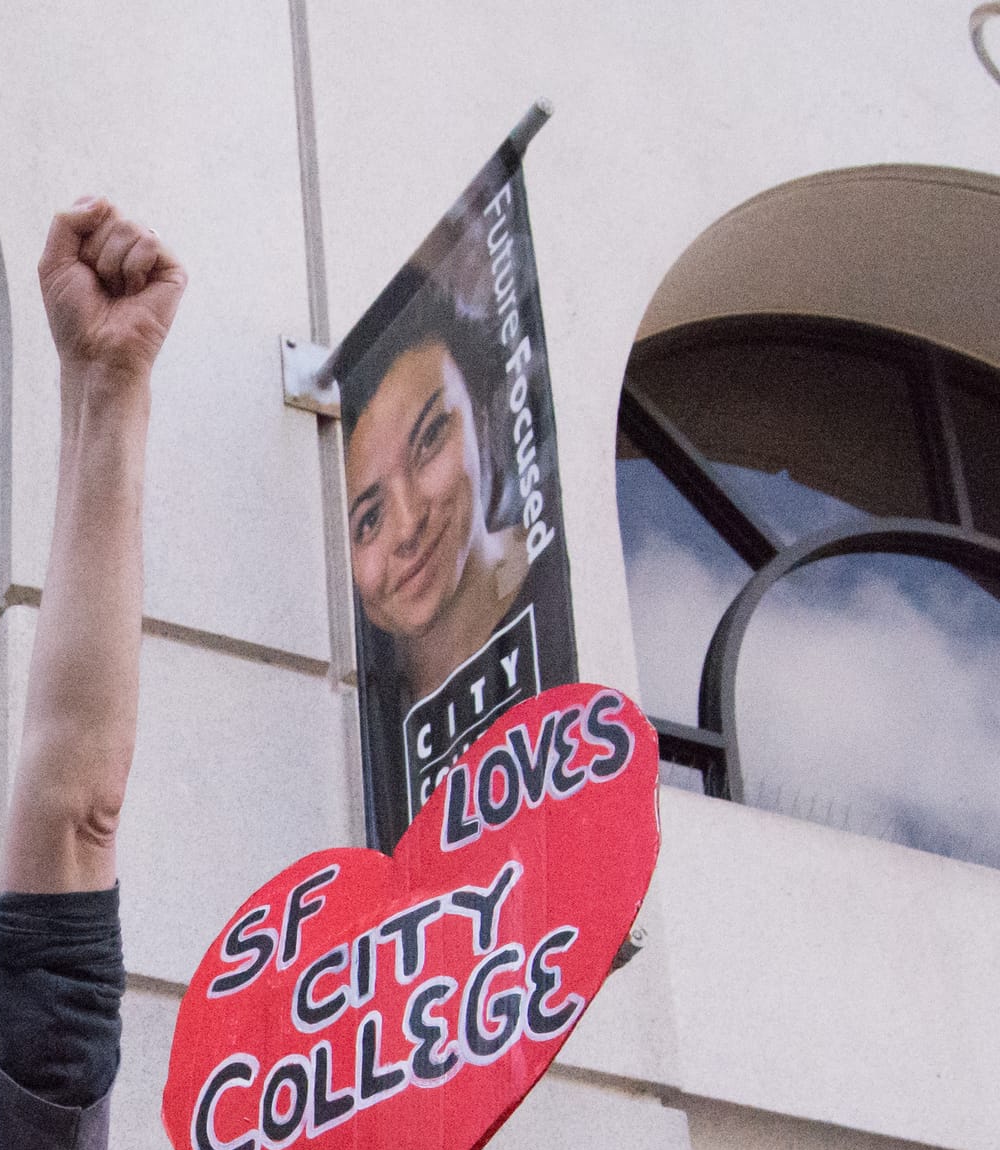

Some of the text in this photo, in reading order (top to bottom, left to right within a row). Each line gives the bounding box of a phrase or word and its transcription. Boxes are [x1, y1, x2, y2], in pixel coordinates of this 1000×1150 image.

[484, 182, 555, 565] Future Focused
[417, 647, 519, 759] CITY
[441, 690, 636, 852] LOVES
[207, 863, 341, 999] SF
[292, 860, 523, 1033] CITY
